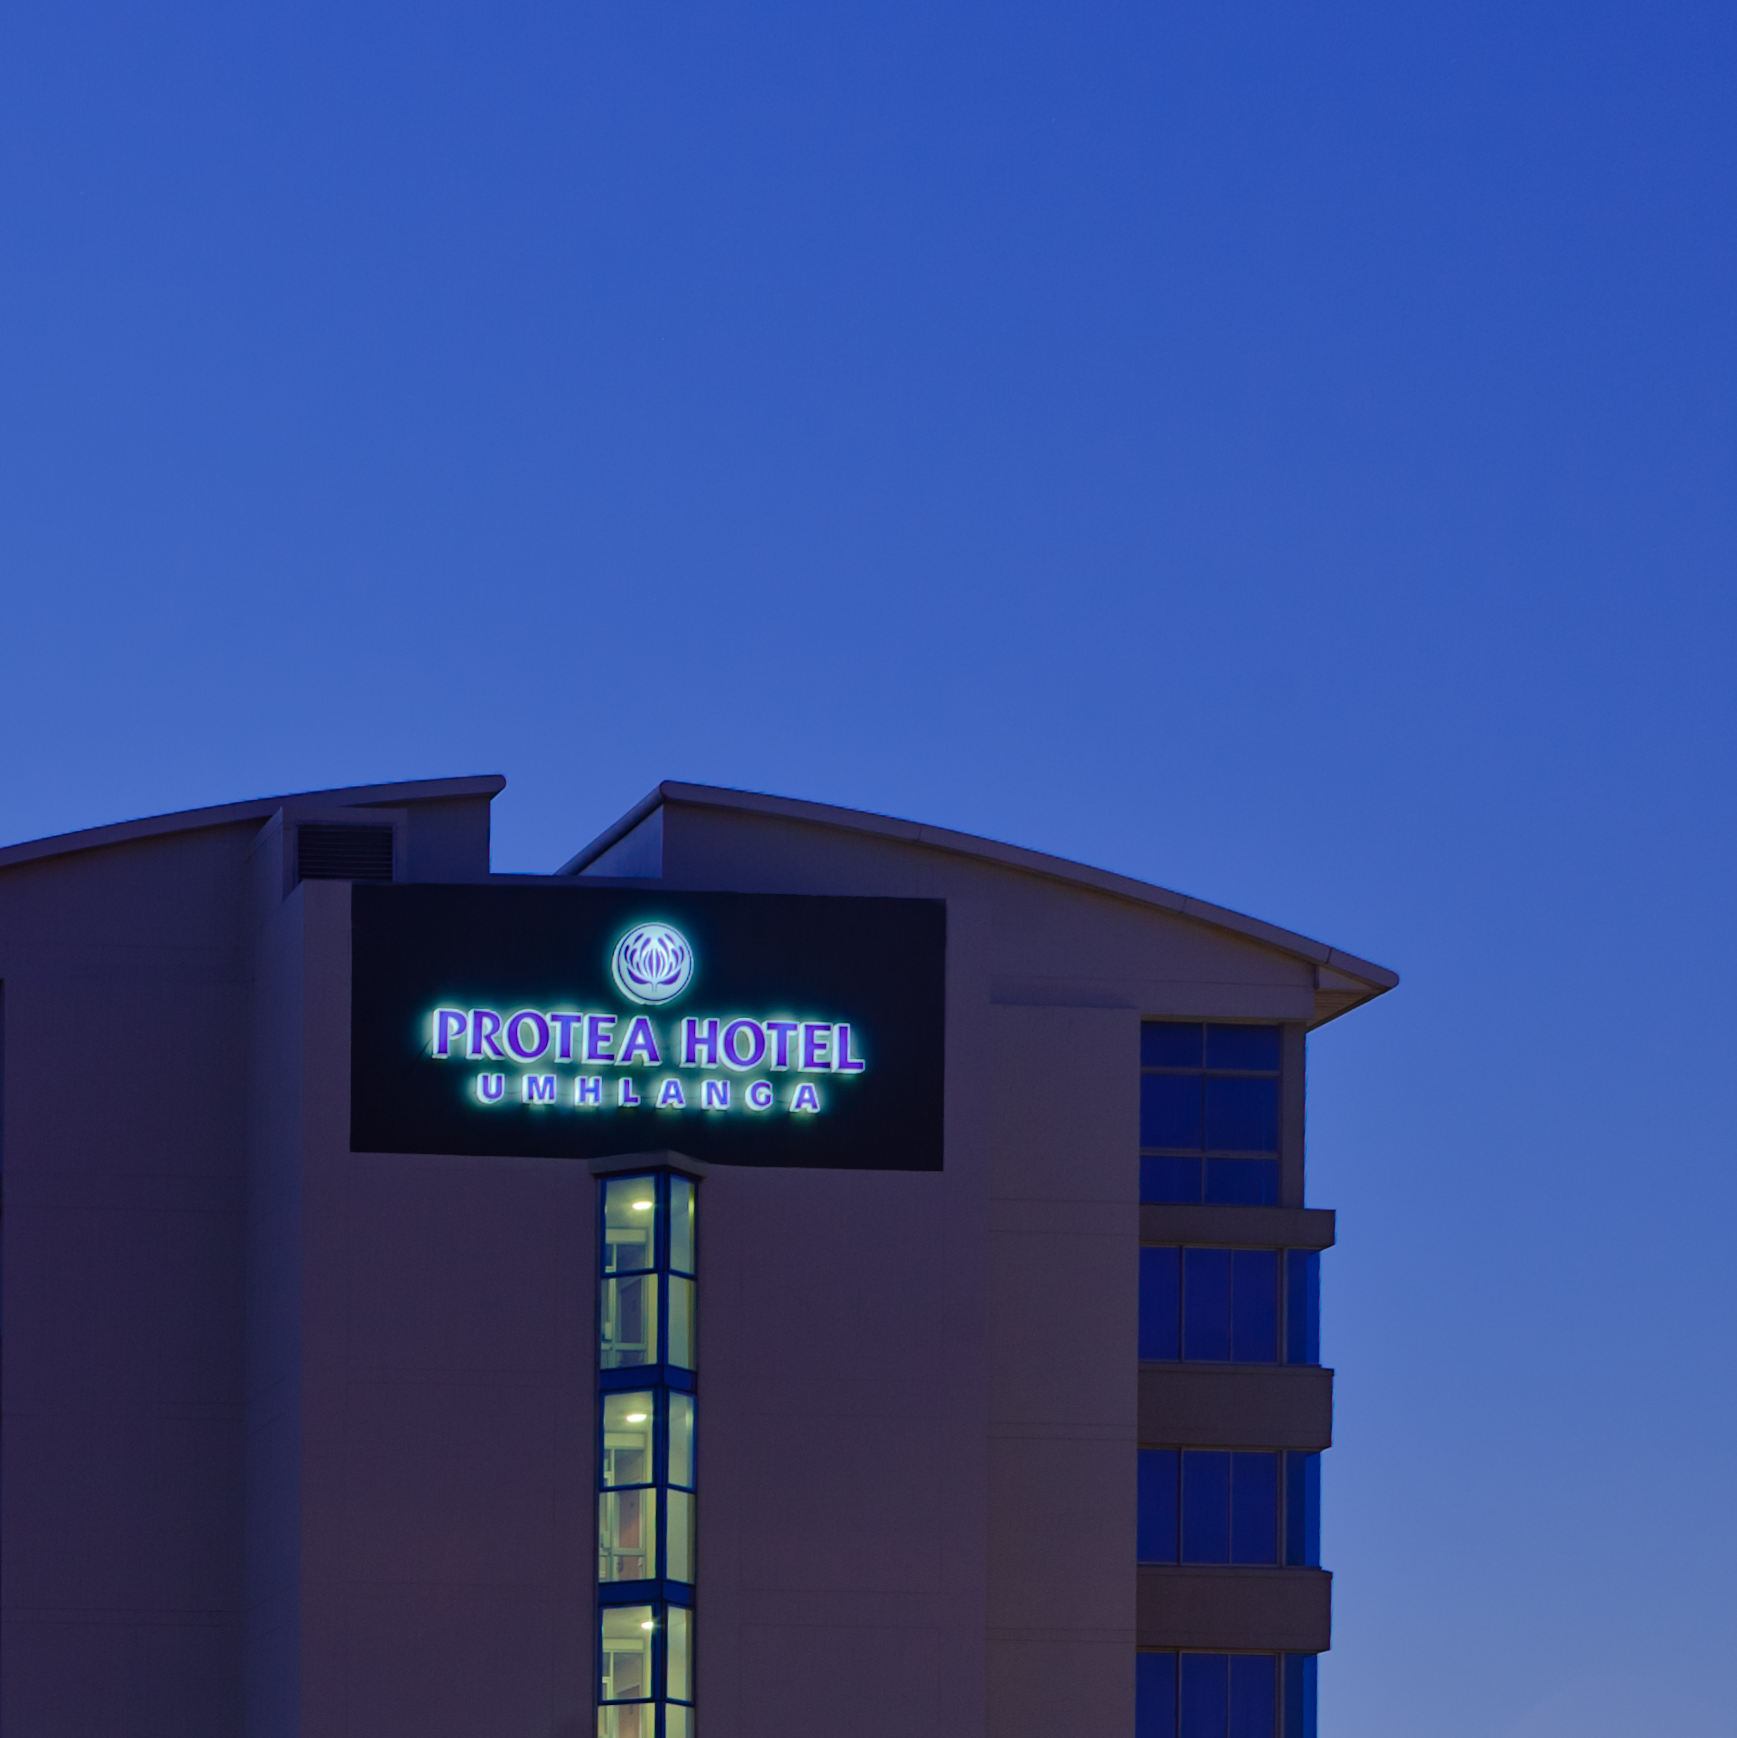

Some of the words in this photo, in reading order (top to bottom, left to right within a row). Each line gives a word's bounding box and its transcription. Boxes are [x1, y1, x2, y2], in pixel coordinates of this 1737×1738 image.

[431, 1007, 663, 1067] PROTEA
[679, 1017, 864, 1073] HOTEL
[477, 1072, 821, 1113] UMHLANGA
